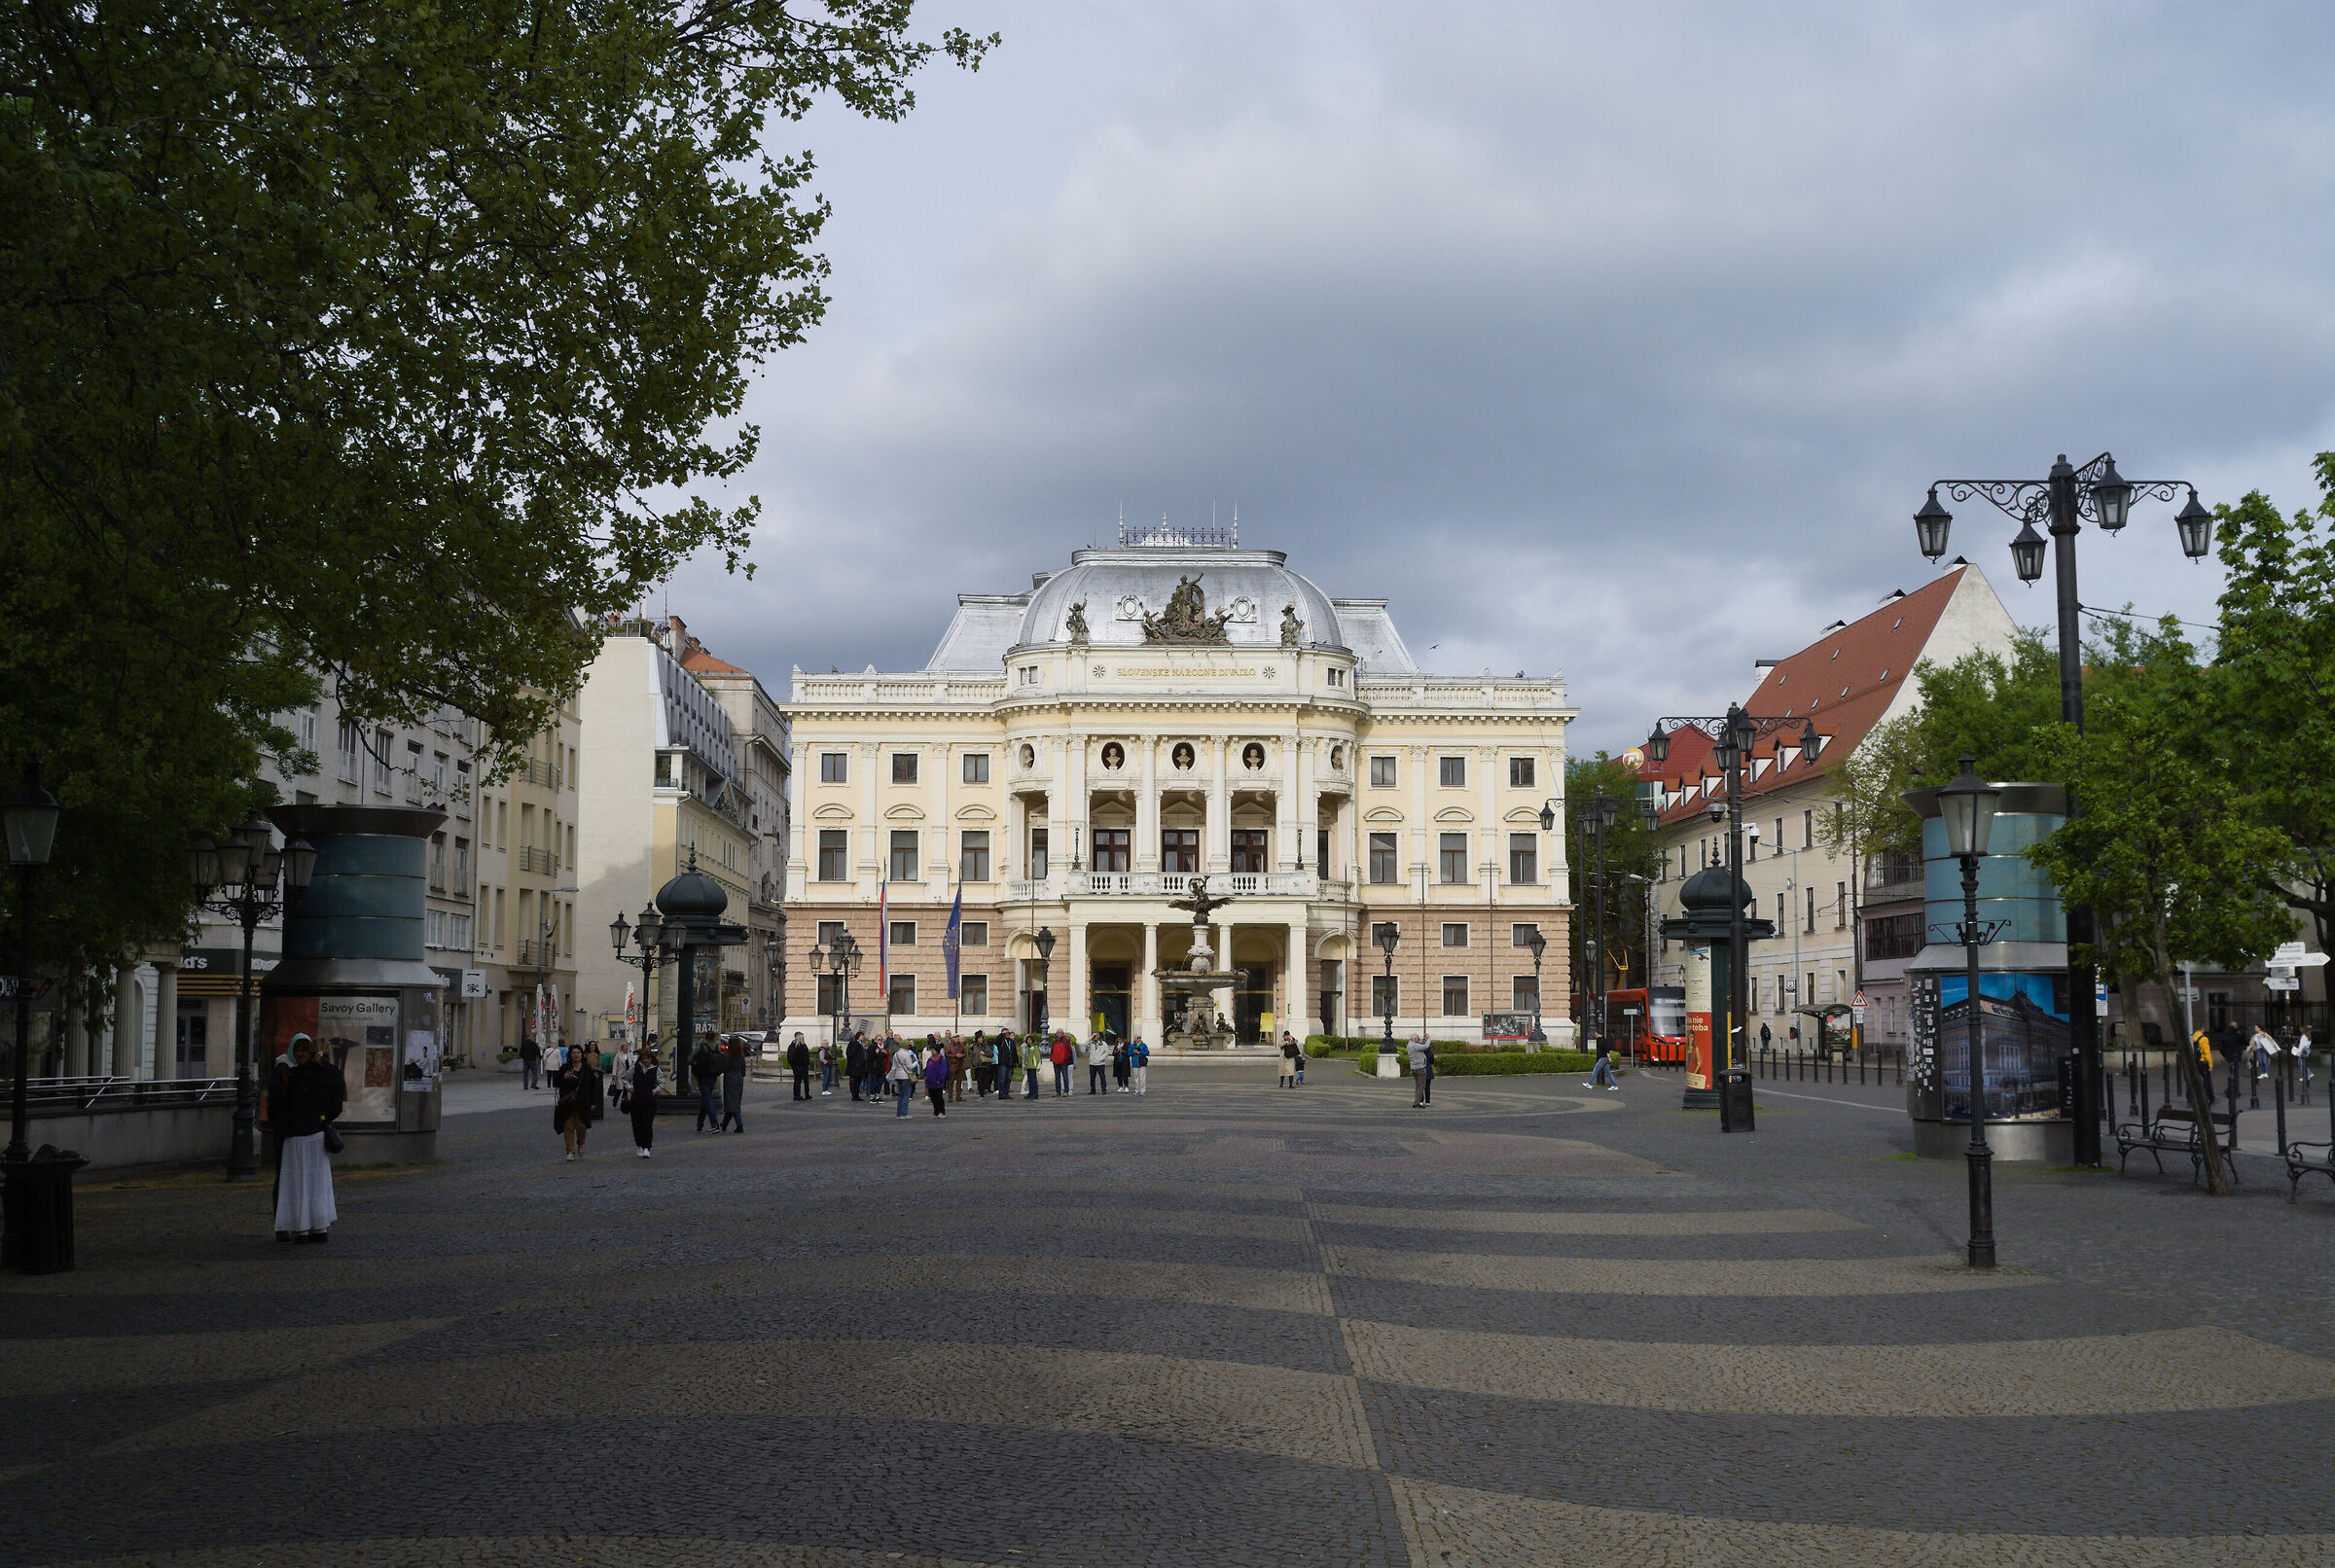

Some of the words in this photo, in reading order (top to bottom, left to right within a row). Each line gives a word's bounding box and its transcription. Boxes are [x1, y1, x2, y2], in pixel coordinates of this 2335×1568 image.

[1117, 666, 1169, 677] SLOVENSKÉ
[1172, 666, 1216, 677] NÁRODNÉ
[1218, 668, 1256, 677] DIVADLO
[321, 1003, 353, 1015] Savoy
[356, 1003, 395, 1016] Gallery
[695, 1021, 719, 1034] RÁZN
